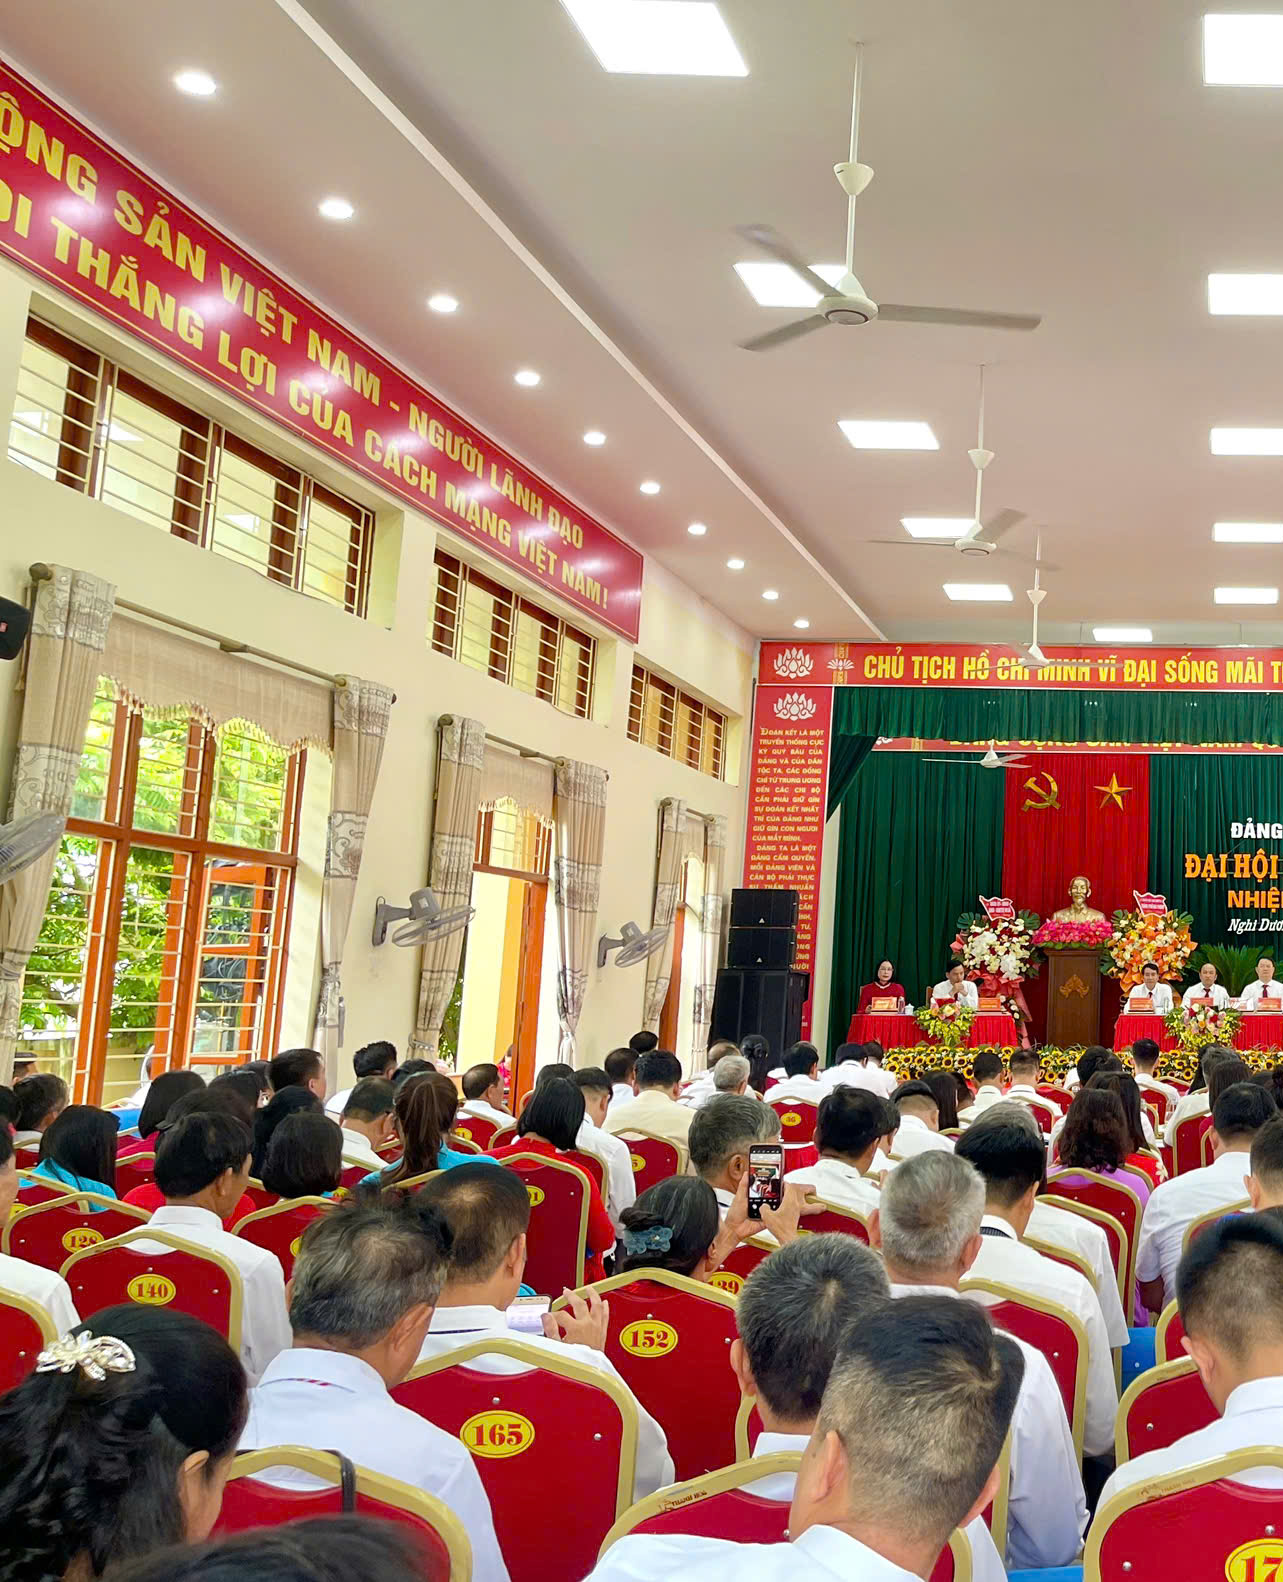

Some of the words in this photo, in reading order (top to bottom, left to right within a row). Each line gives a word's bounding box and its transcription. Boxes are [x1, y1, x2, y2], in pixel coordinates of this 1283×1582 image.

[50, 215, 206, 351] THẮNG
[218, 330, 277, 397] LỢI
[289, 379, 354, 447] CỦA
[445, 481, 511, 548] MẠNG
[113, 190, 207, 283] SẢN
[220, 263, 298, 345] VIỆT
[307, 329, 381, 407] NAM
[408, 402, 485, 480] NGƯỜI
[490, 463, 543, 521] LÃNH
[548, 505, 583, 550] ĐẠO
[864, 646, 904, 679] CHỦ
[912, 655, 960, 684] TỊCH
[963, 649, 989, 680] HỒ
[1037, 658, 1091, 681] MINH
[1098, 654, 1117, 682] VĨ
[1123, 659, 1156, 687] ĐẠI
[1164, 652, 1218, 683] SỐNG
[1225, 656, 1264, 685] MÃI
[1230, 818, 1283, 840] ĐẢNG
[1184, 853, 1228, 882] ĐẠI
[1234, 849, 1278, 882] HỘI
[1227, 918, 1257, 934] Nghi
[136, 1280, 167, 1298] 140
[631, 1329, 668, 1349] 152
[470, 1421, 522, 1445] 165
